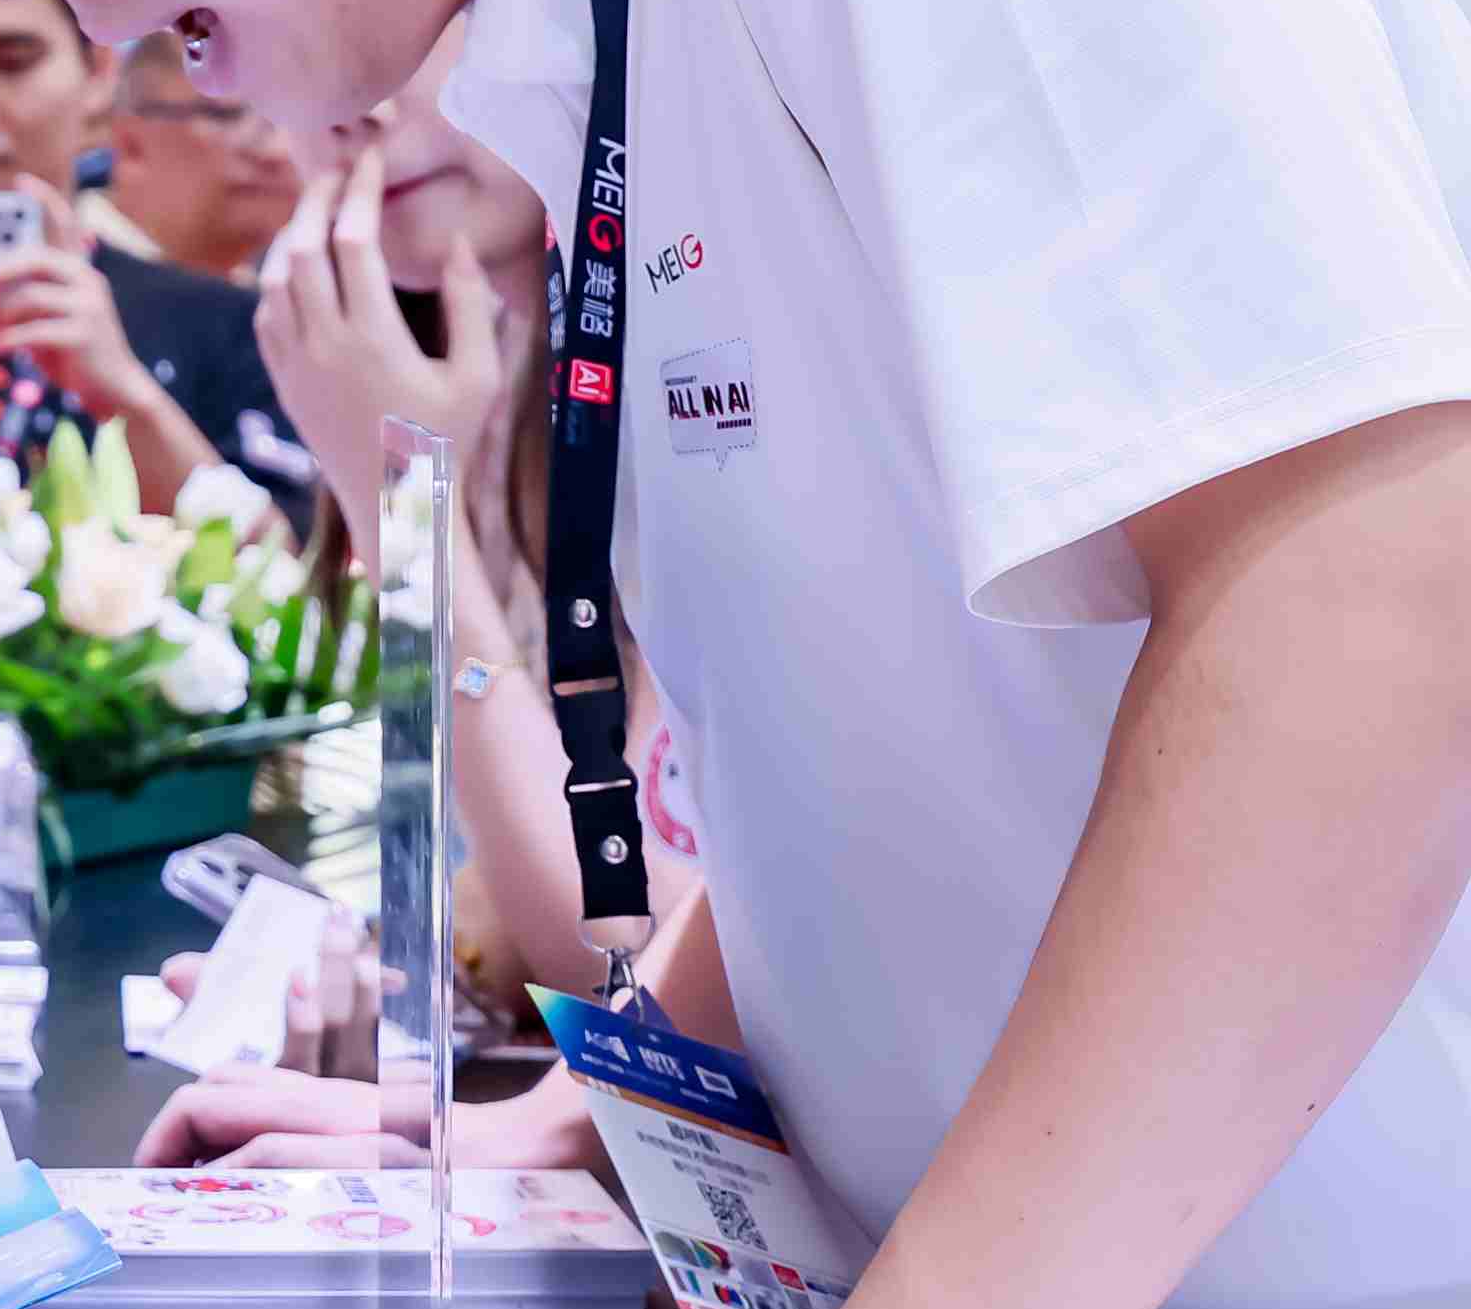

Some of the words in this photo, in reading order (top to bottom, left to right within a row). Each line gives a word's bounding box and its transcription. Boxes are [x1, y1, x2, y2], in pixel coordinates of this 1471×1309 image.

[587, 136, 626, 254] MEIG
[580, 258, 617, 339] 美格
[645, 233, 704, 295] MEIG
[667, 388, 701, 420] ALL
[701, 384, 725, 417] IN
[727, 381, 751, 414] AI
